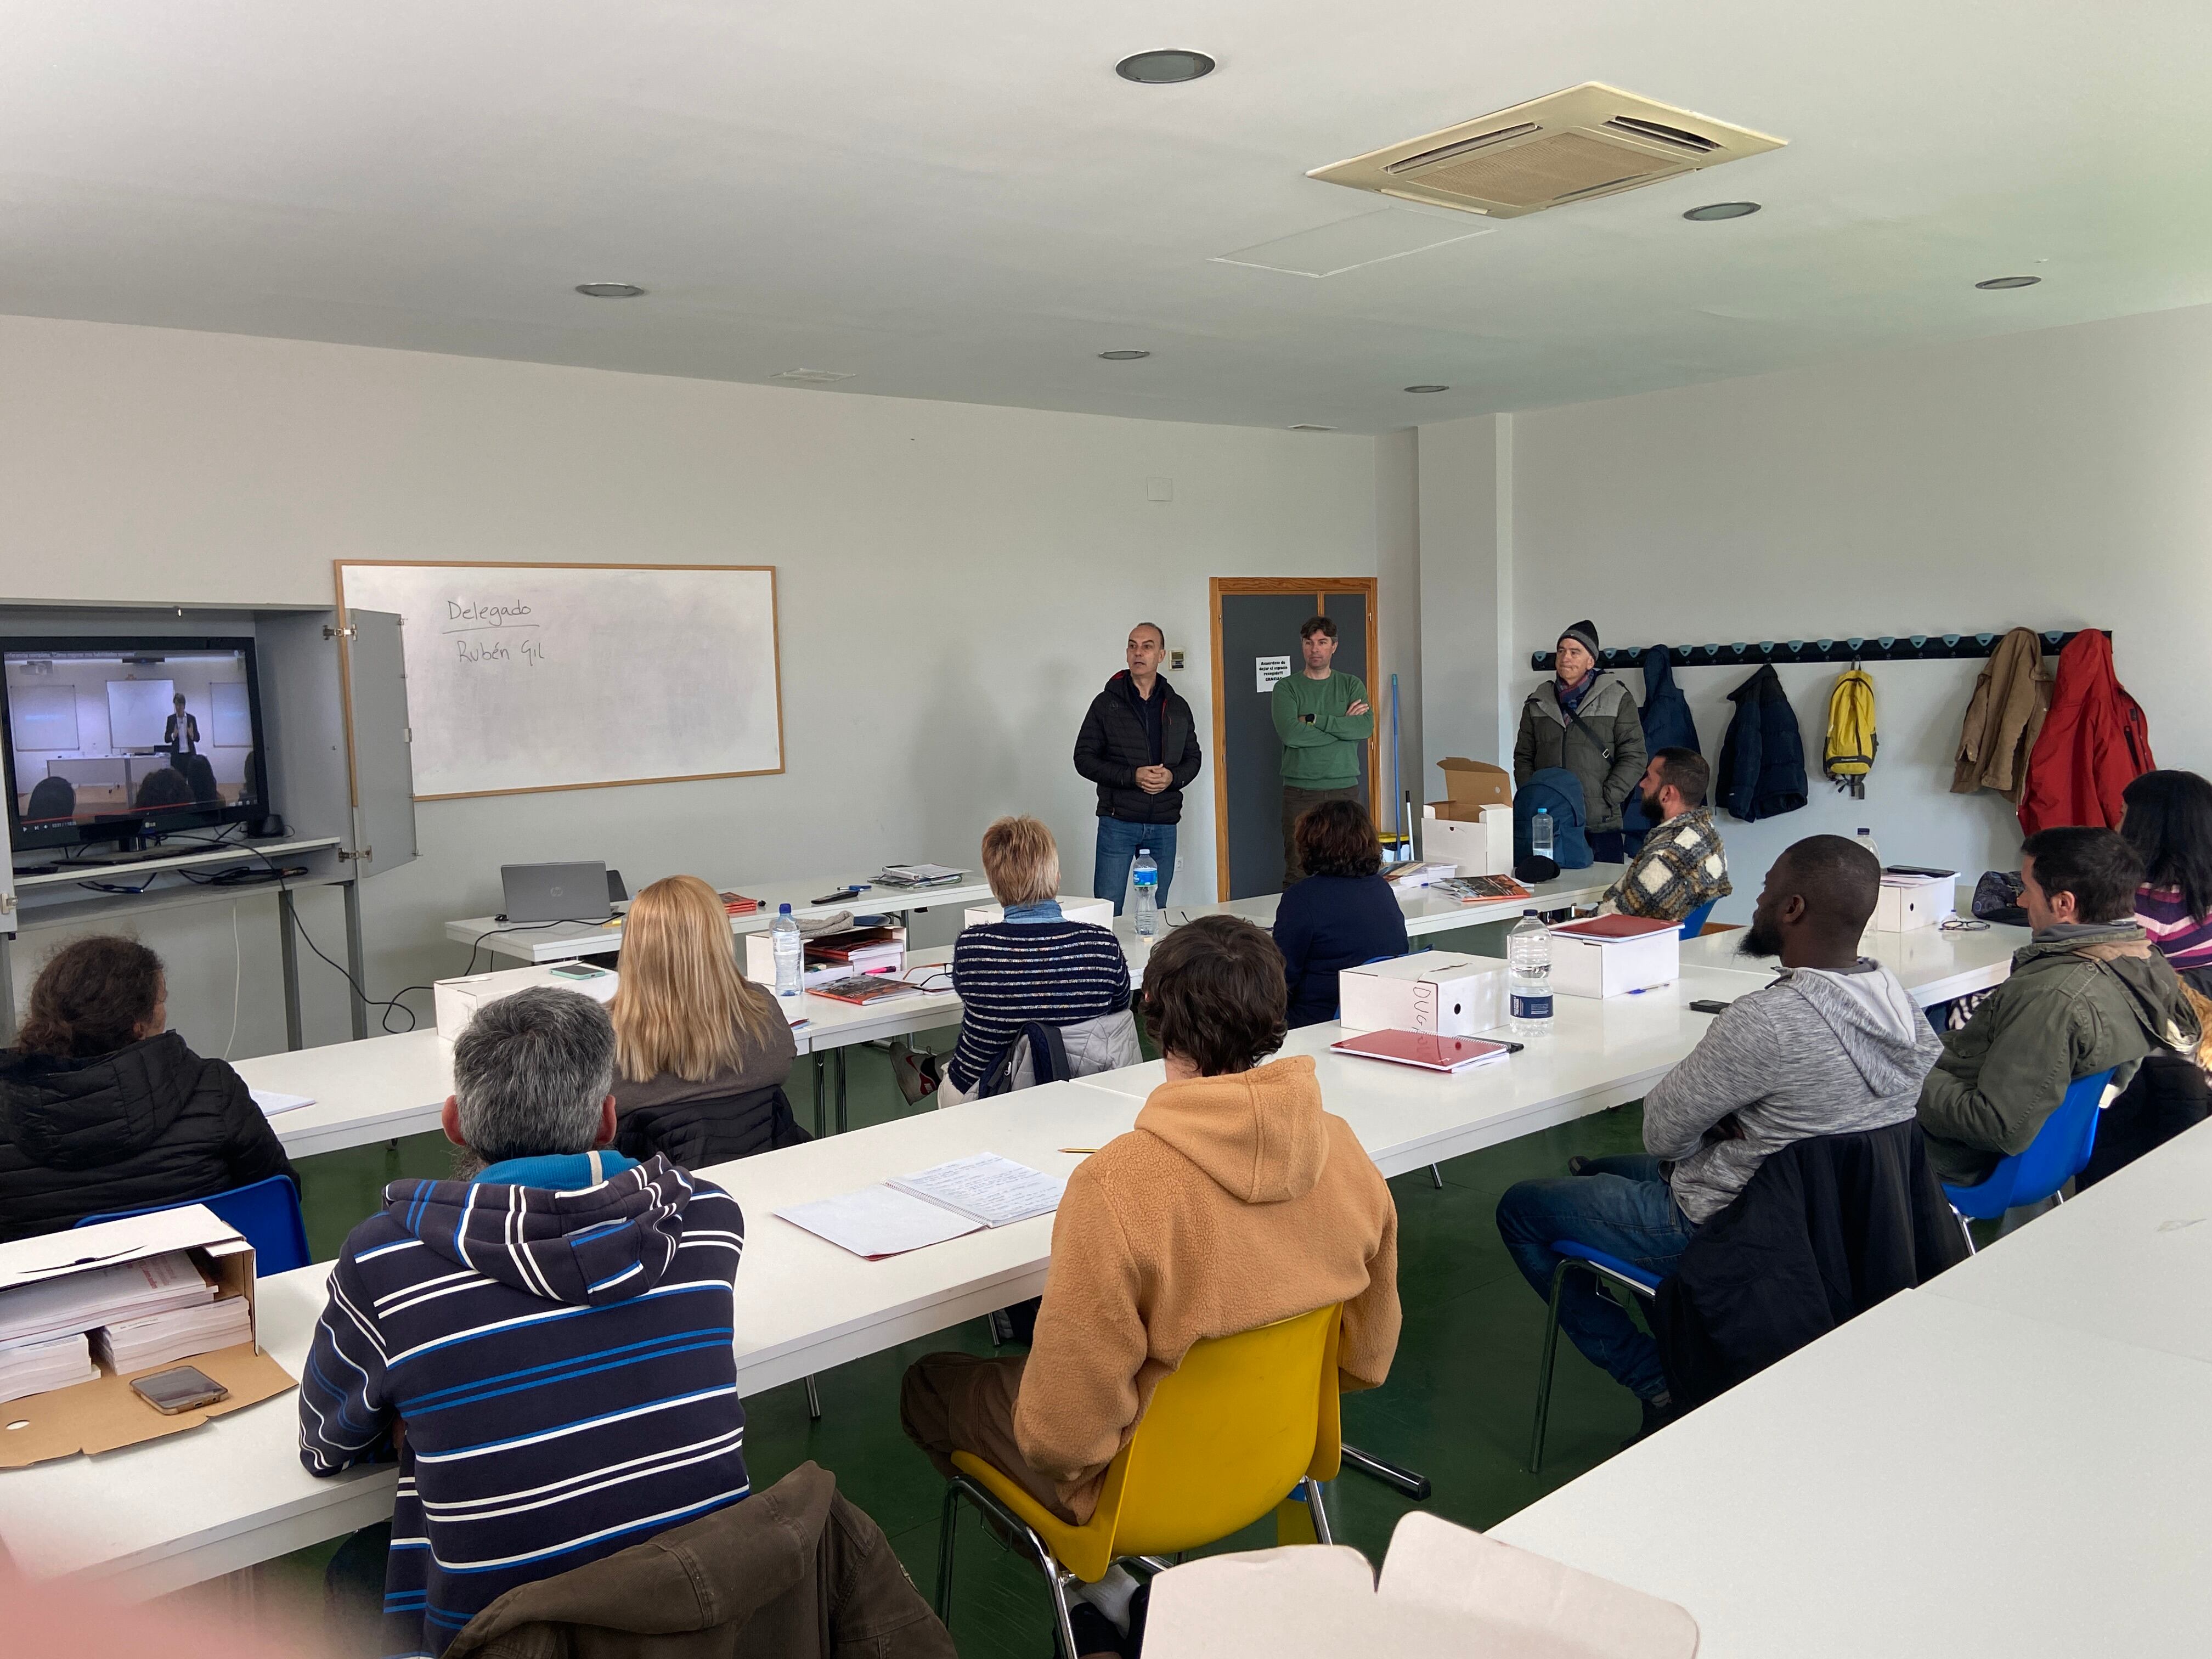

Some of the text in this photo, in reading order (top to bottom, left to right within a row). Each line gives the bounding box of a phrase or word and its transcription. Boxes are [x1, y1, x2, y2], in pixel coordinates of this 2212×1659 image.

[448, 599, 532, 627] Delegado
[457, 640, 545, 666] Rubén Gil
[1412, 987, 1431, 1030] DUG
